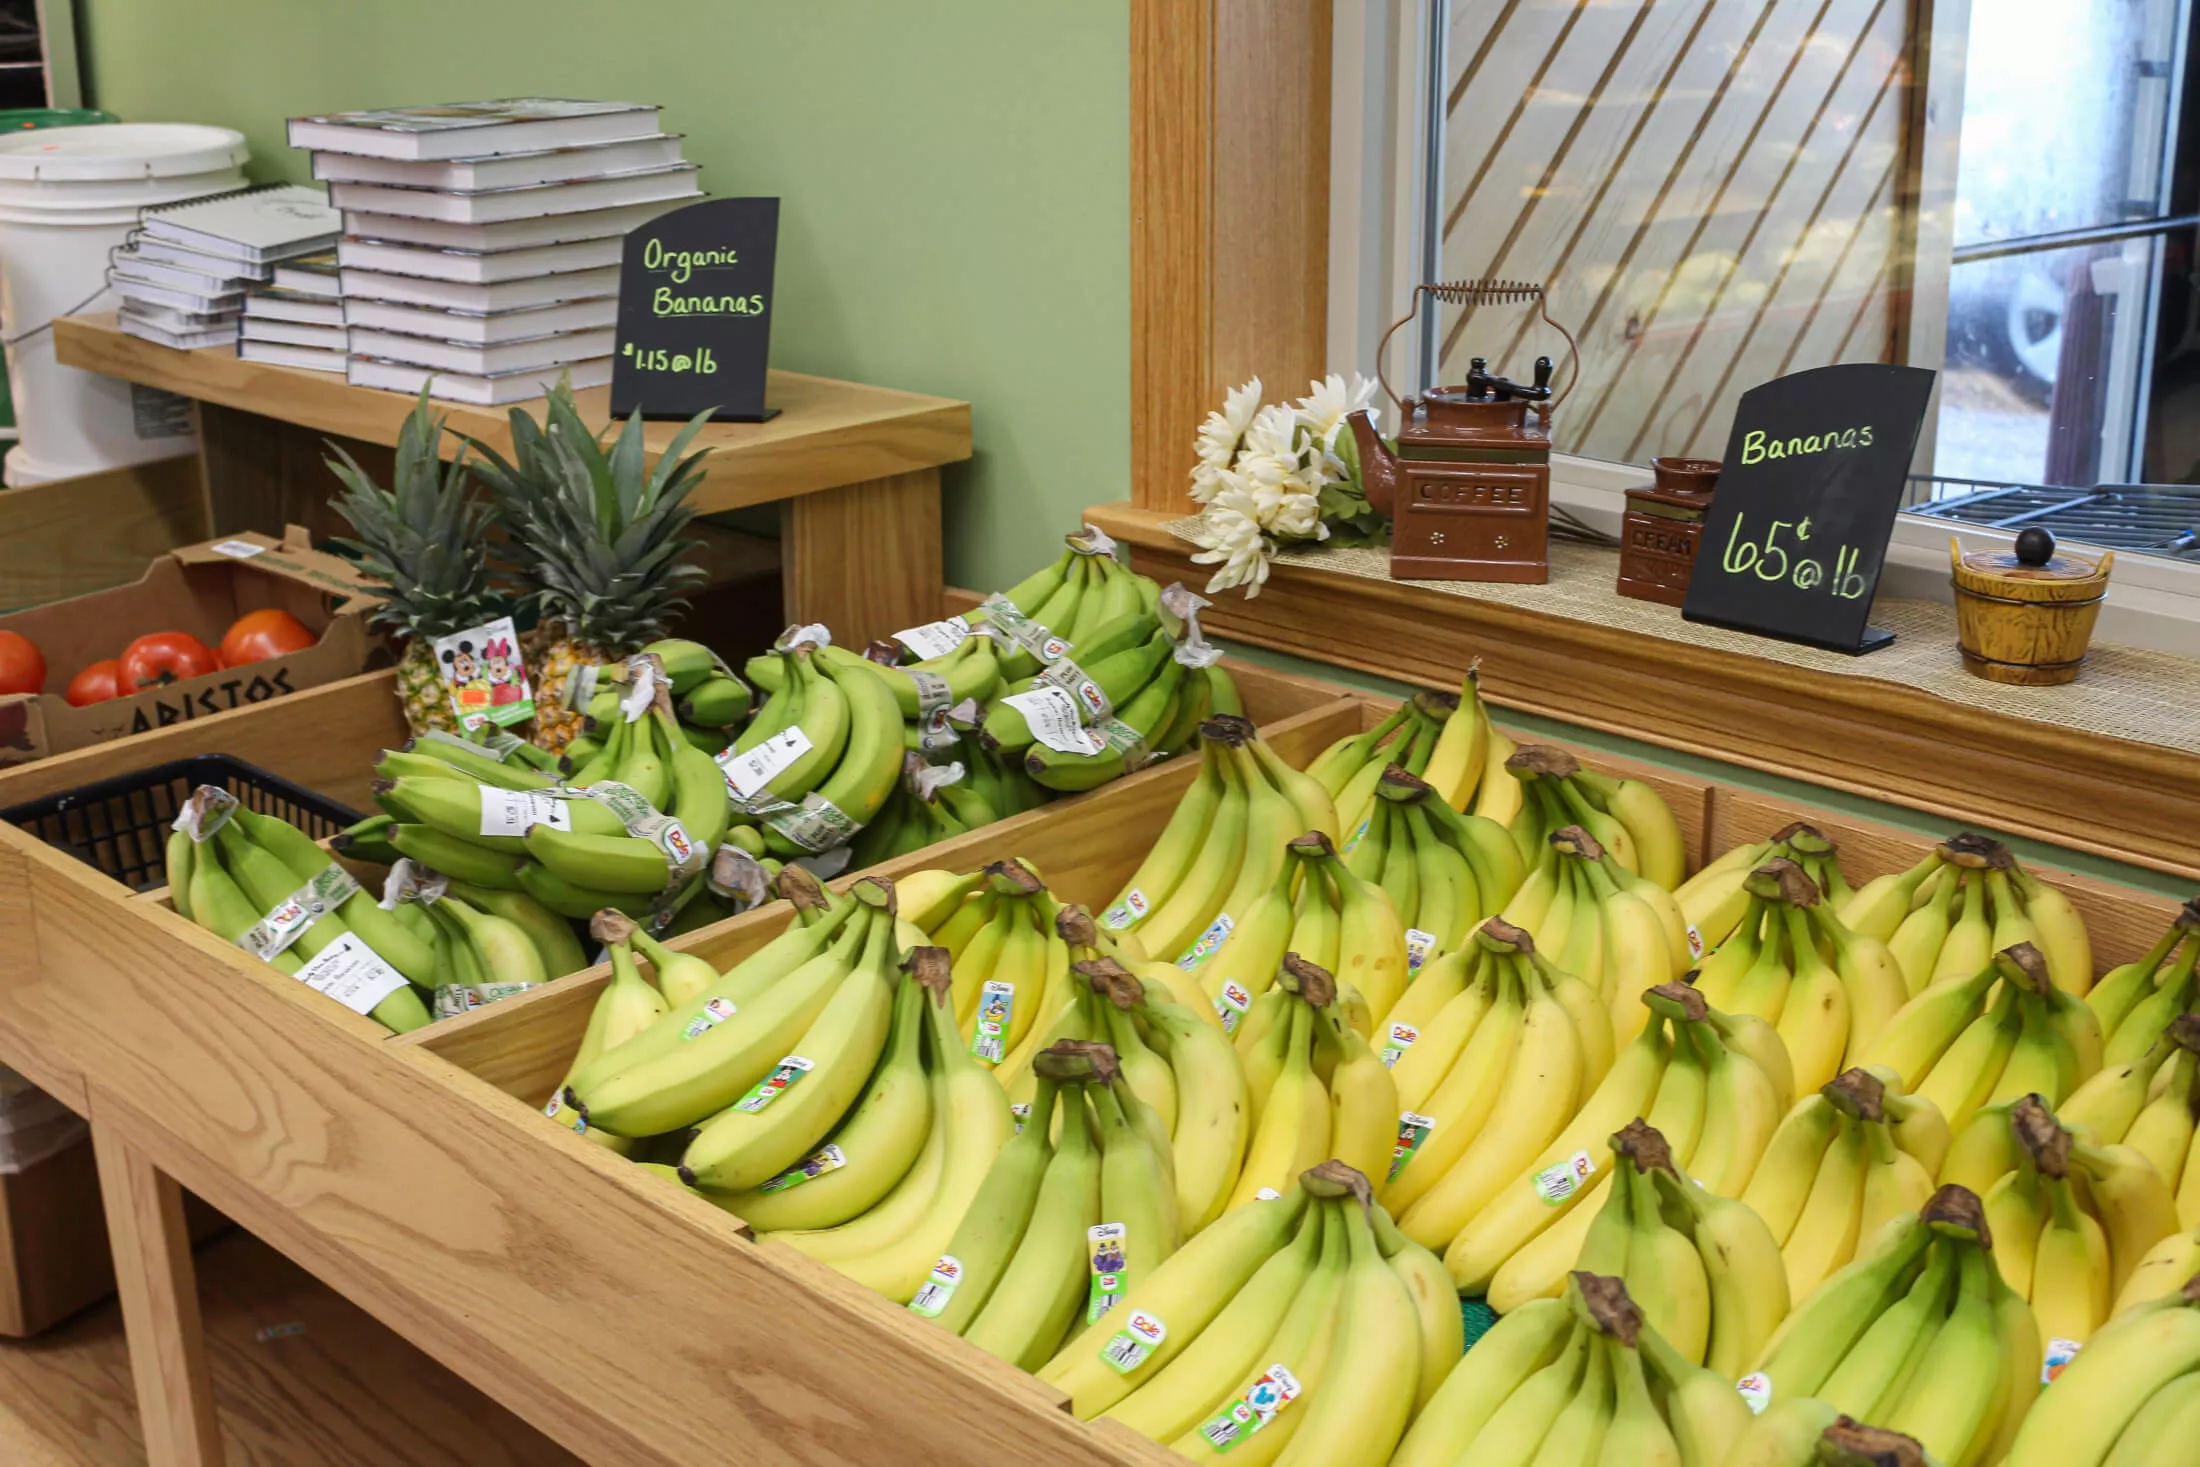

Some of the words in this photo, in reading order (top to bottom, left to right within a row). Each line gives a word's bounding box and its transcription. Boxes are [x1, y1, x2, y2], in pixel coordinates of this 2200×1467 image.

[644, 238, 738, 283] Organic
[653, 287, 765, 315] Bananas
[1741, 425, 1873, 465] Bananas
[1420, 483, 1526, 504] COFFEE
[669, 830, 689, 857] Dole
[1133, 1315, 1161, 1337] Dole
